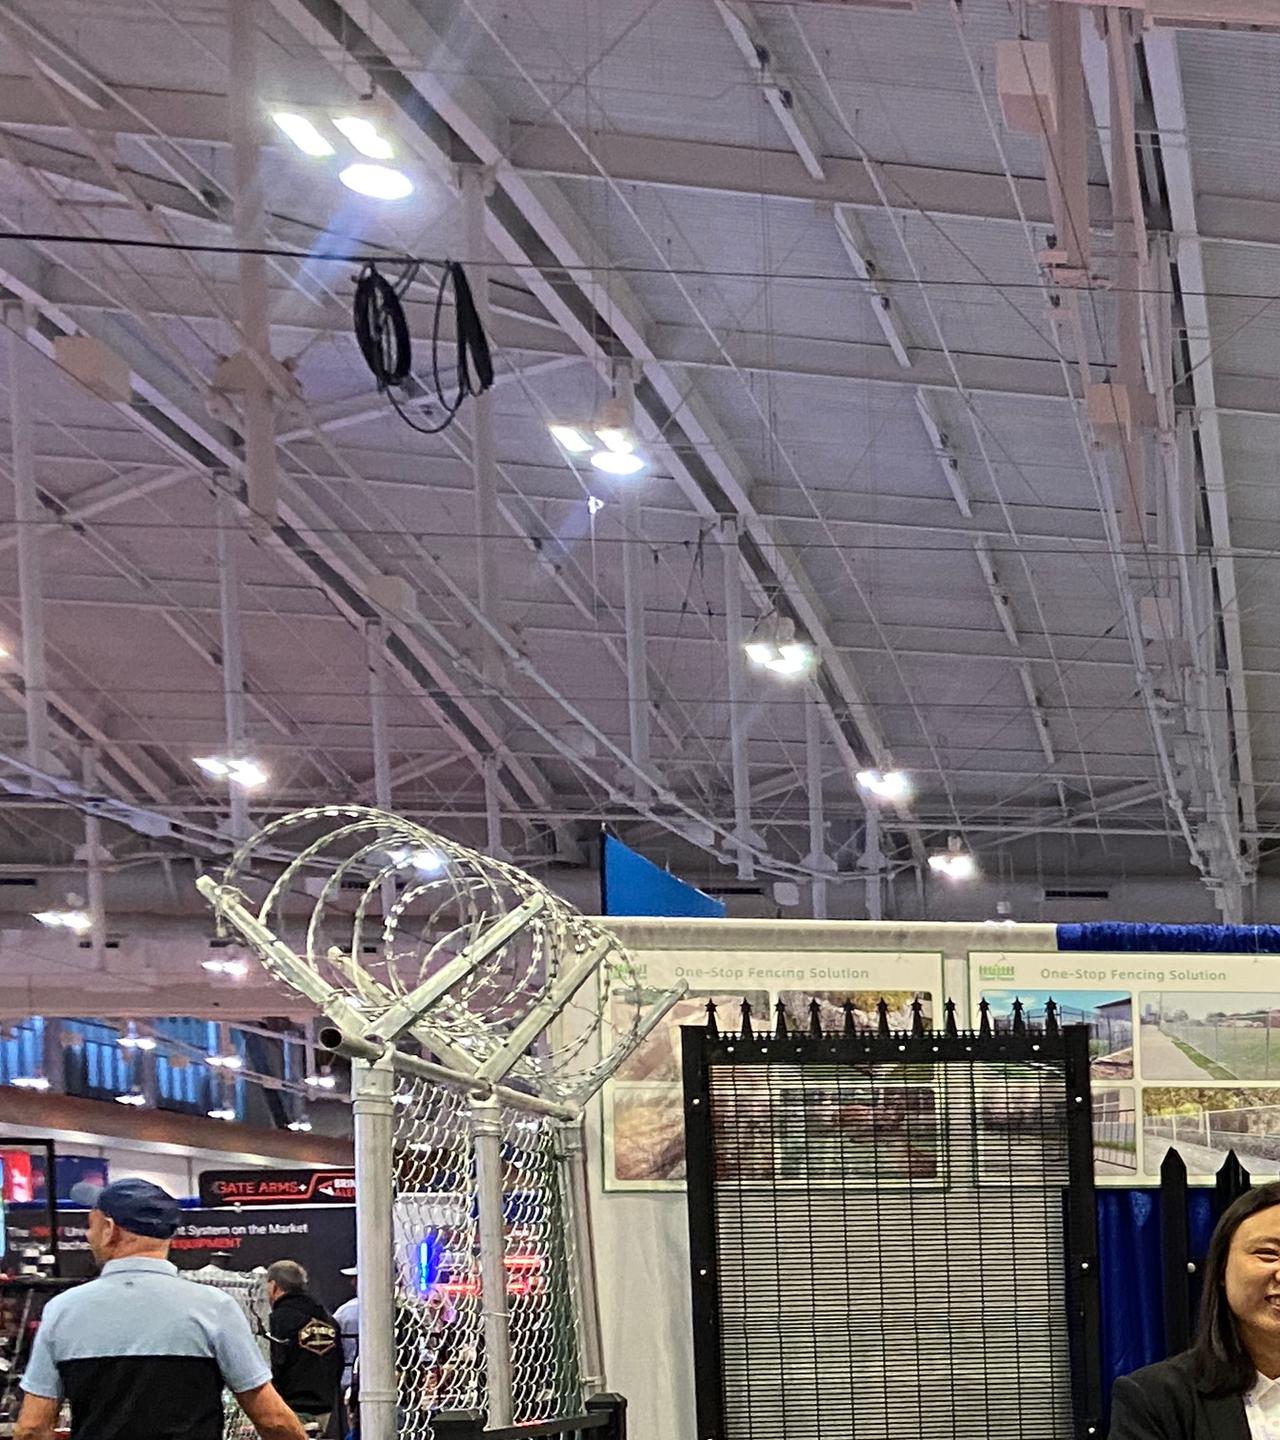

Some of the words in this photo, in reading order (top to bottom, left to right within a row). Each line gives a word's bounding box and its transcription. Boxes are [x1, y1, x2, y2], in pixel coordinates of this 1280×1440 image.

[749, 967, 804, 980] Fencing
[810, 967, 869, 979] Solution
[1040, 968, 1106, 981] One-Stop
[1111, 969, 1164, 981] Fencing
[1169, 969, 1226, 981] Solution
[258, 1181, 298, 1193] ARMS
[231, 1226, 246, 1235] on
[248, 1224, 266, 1235] the
[269, 1223, 308, 1234] Market
